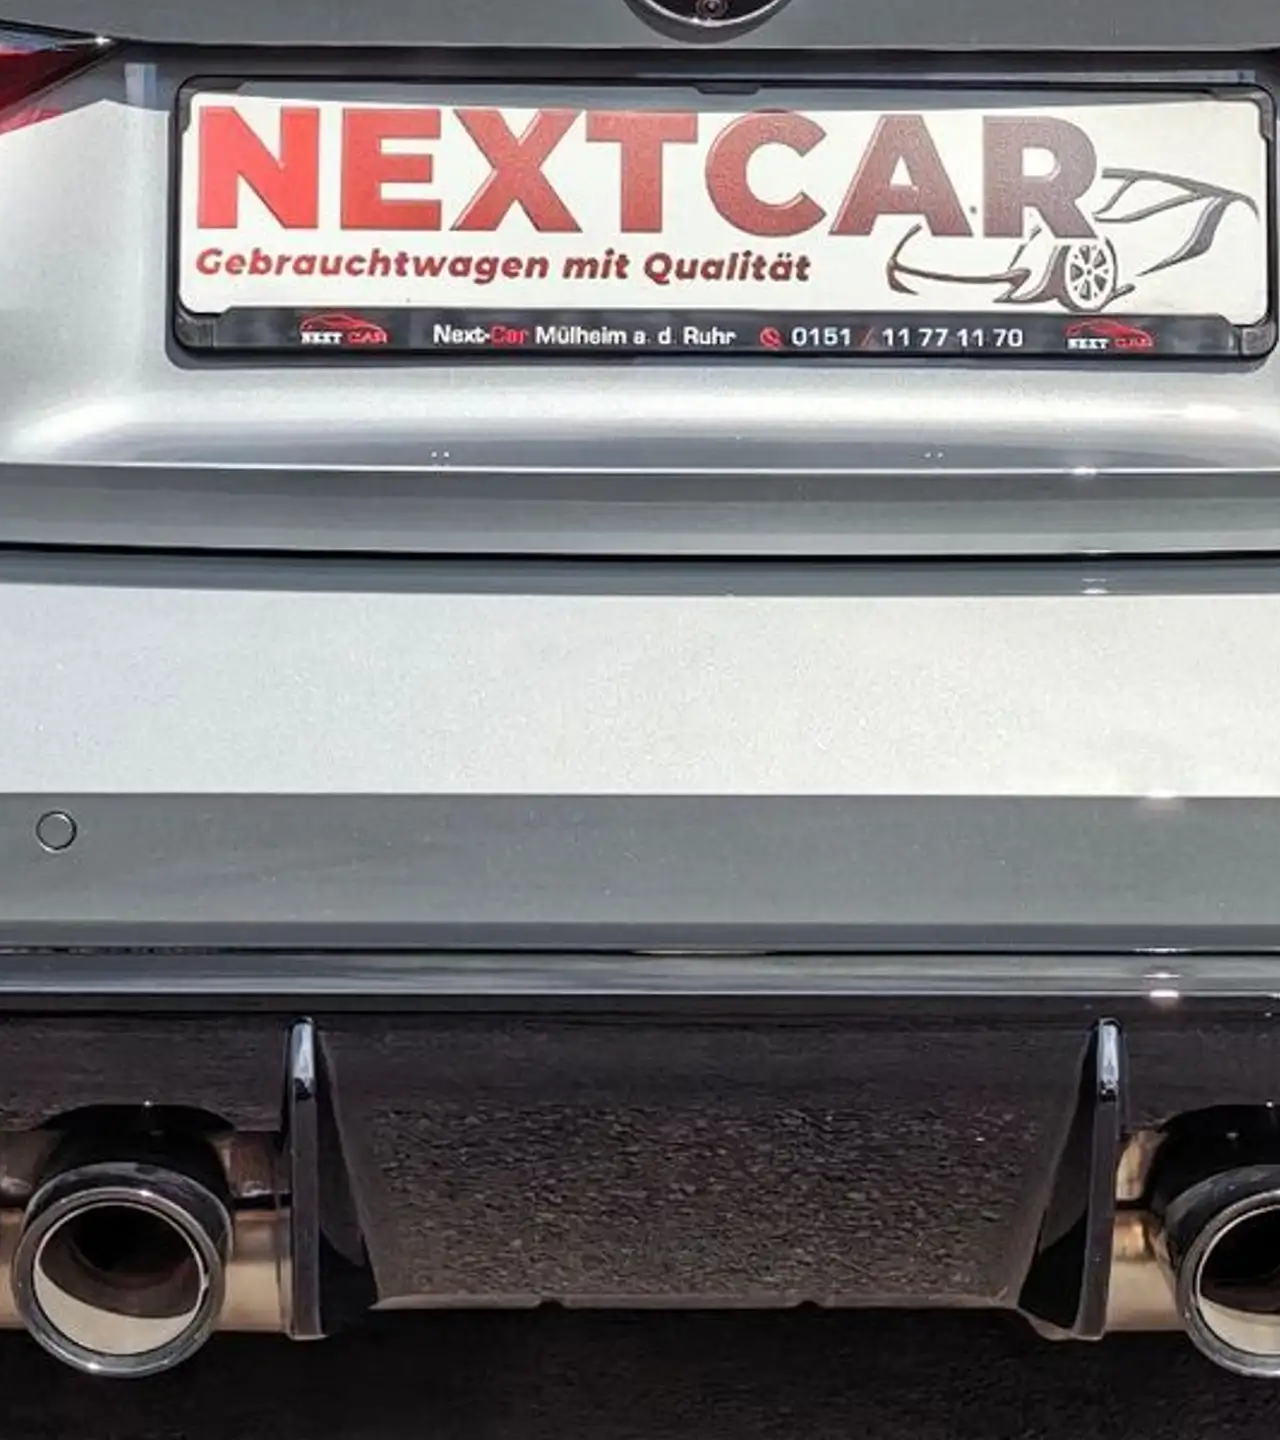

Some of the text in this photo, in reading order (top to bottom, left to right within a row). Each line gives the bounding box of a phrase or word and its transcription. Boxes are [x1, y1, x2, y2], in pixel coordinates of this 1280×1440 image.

[197, 106, 1097, 238] NEXTCAR
[196, 248, 812, 285] Gebrauchtwagen mit Qualität
[535, 324, 627, 345] Mülheim
[683, 326, 736, 345] Ruhr
[791, 326, 851, 347] 0151
[882, 328, 910, 347] 11
[919, 328, 948, 347] 77
[957, 328, 984, 347] 11
[993, 328, 1023, 347] 70
